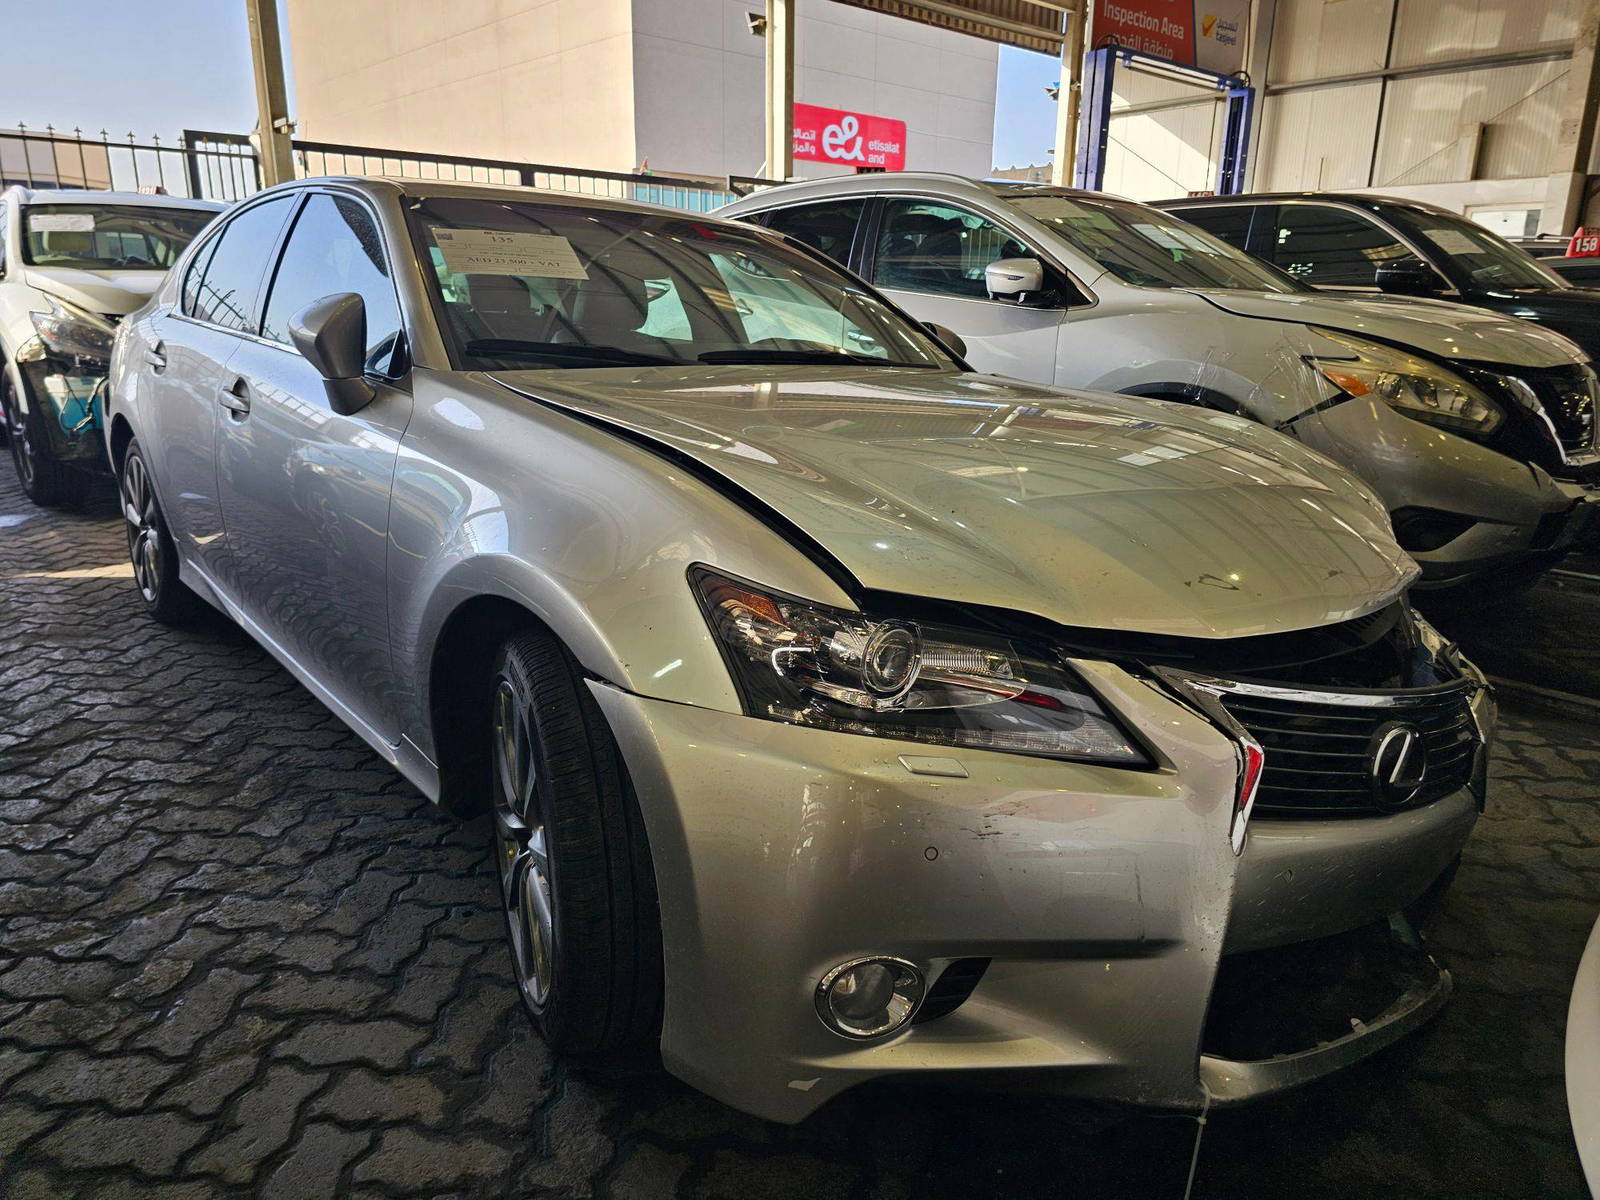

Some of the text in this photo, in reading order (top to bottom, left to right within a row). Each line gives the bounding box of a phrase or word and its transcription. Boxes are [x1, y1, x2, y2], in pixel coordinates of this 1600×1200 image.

[1103, 2, 1185, 39] Inspection Area
[1143, 38, 1174, 60] منطقة
[868, 140, 900, 154] etisalat
[868, 154, 885, 164] and
[1575, 237, 1599, 252] 158
